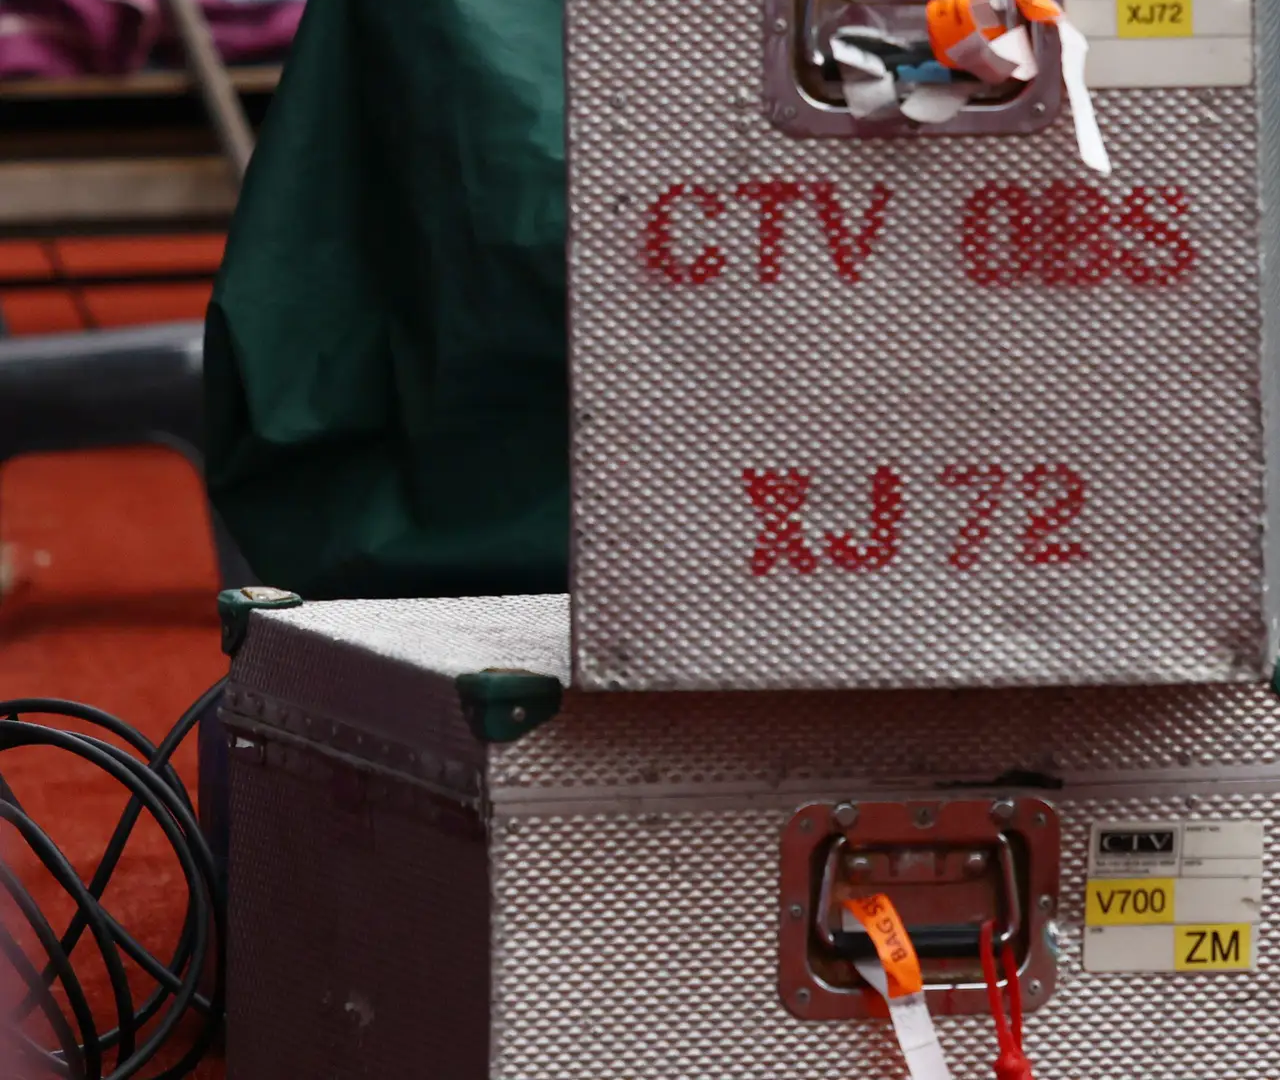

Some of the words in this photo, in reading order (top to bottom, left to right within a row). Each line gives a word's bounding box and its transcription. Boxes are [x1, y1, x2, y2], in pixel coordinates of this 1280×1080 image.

[1126, 4, 1184, 25] XJ72
[642, 180, 890, 286] CTV
[957, 180, 1198, 289] OBS
[1102, 834, 1171, 853] CTV
[1096, 888, 1166, 915] V700
[875, 917, 908, 963] BAG
[1185, 930, 1241, 965] ZM
